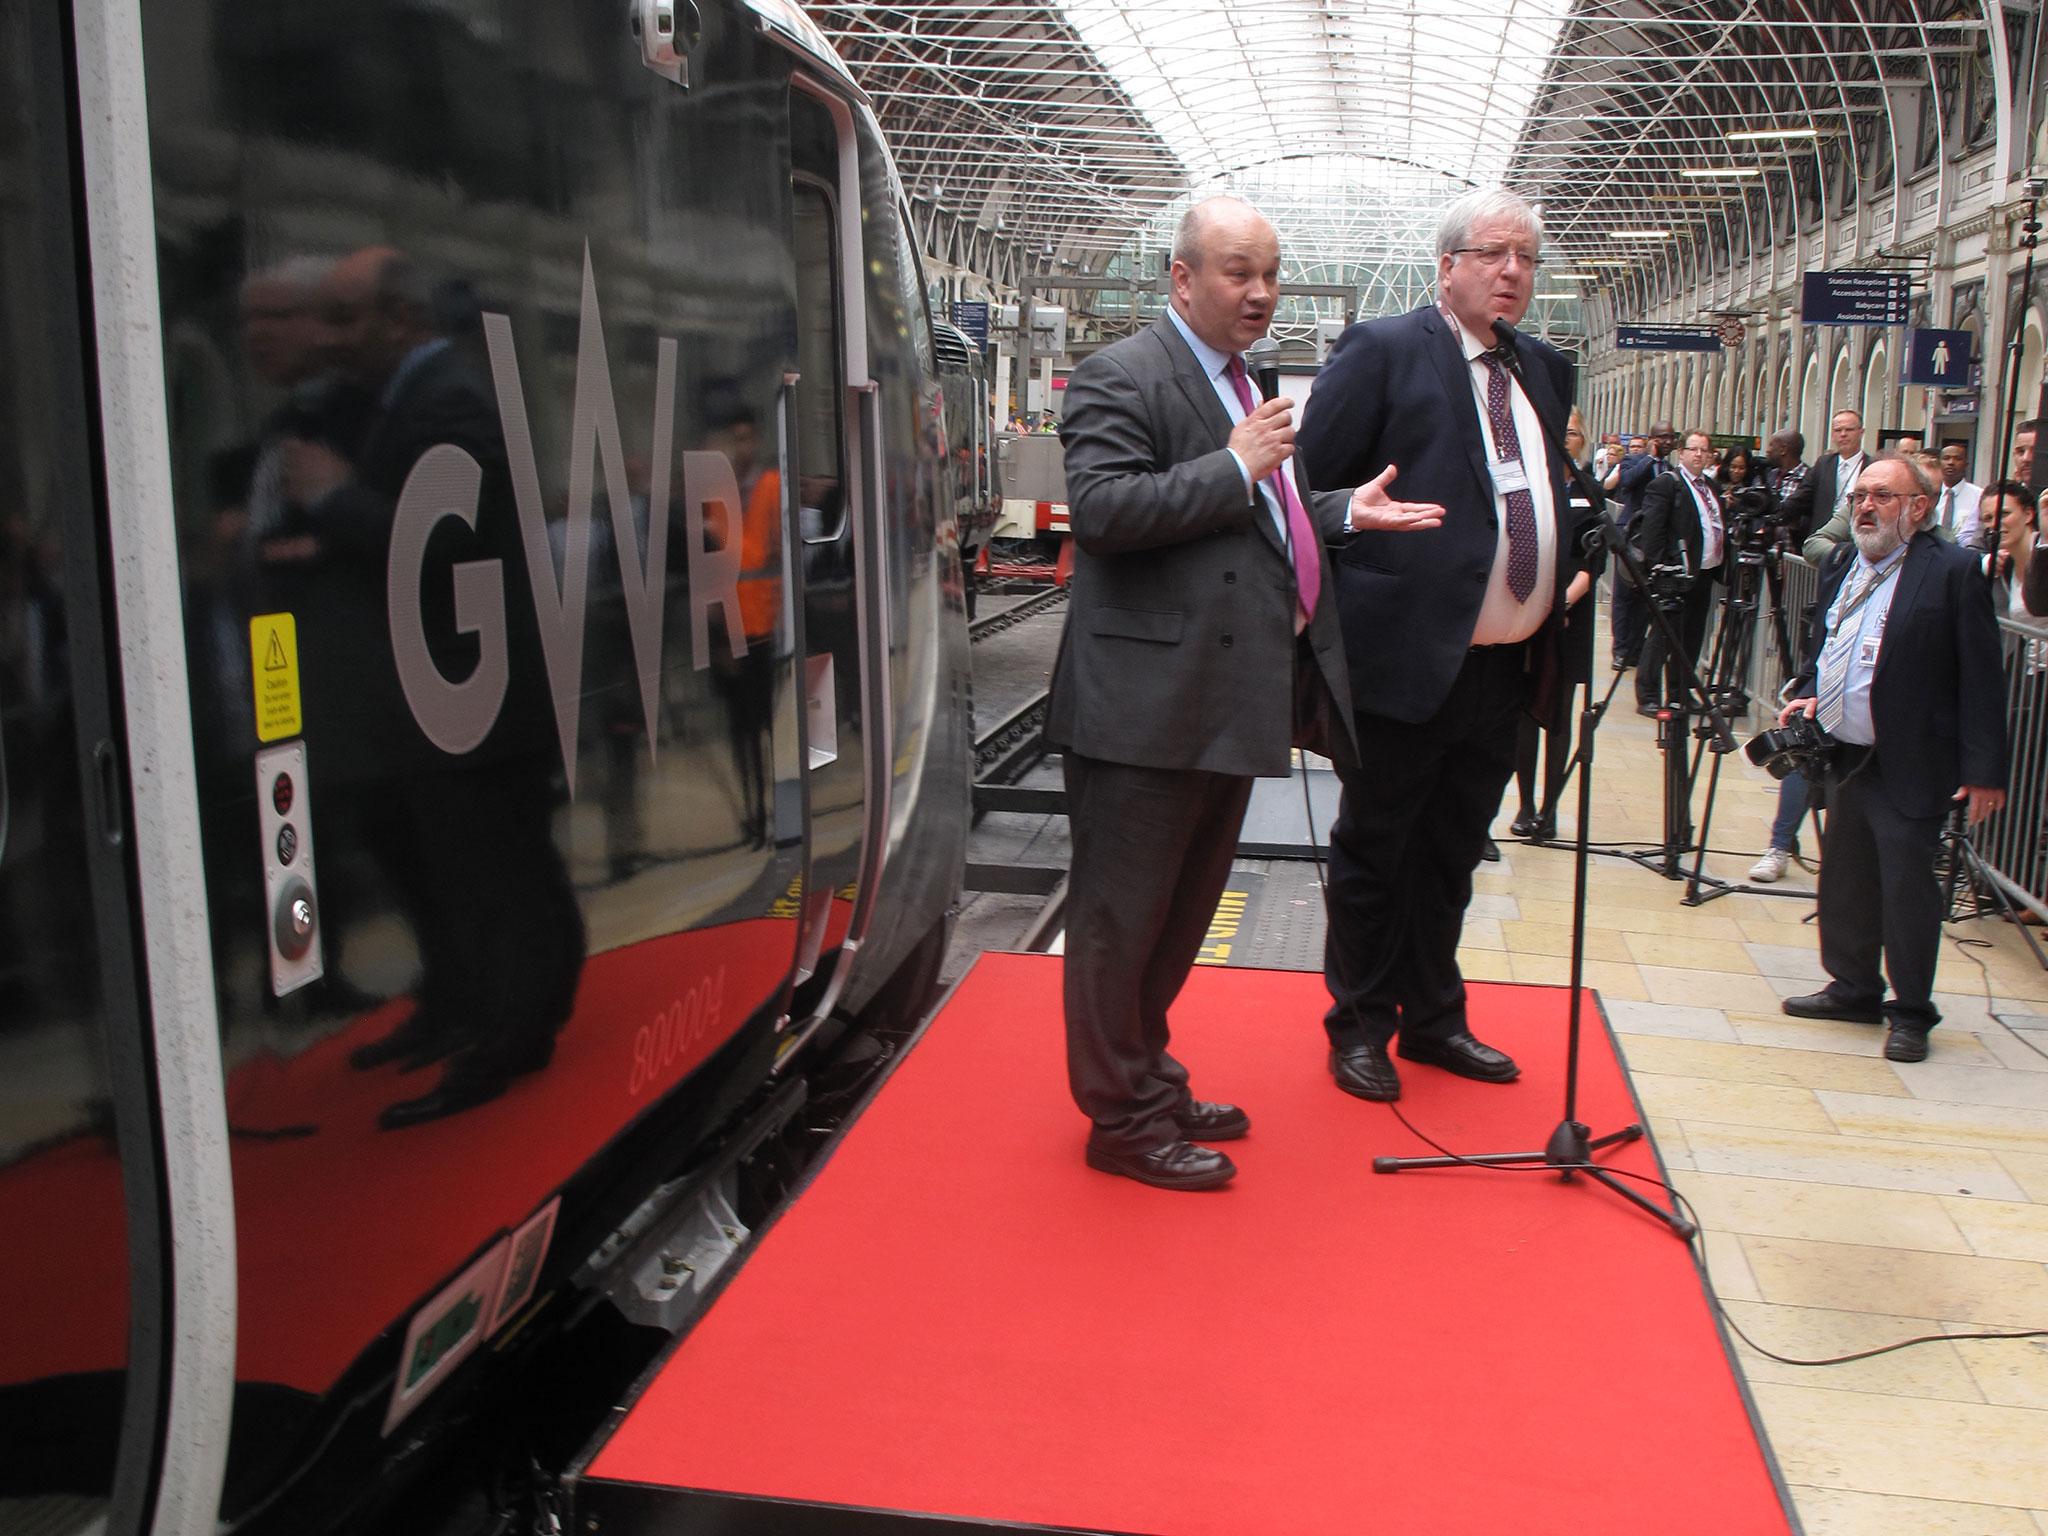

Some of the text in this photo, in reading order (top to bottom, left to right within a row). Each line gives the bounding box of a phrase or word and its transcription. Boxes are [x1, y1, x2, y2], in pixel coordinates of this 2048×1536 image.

[1828, 277, 1887, 286] Station Reception
[1832, 289, 1866, 297] Accessible
[1855, 301, 1886, 310] Babycare
[1836, 312, 1865, 320] Assisted
[388, 237, 749, 799] GWR
[630, 964, 726, 1096] 800004
